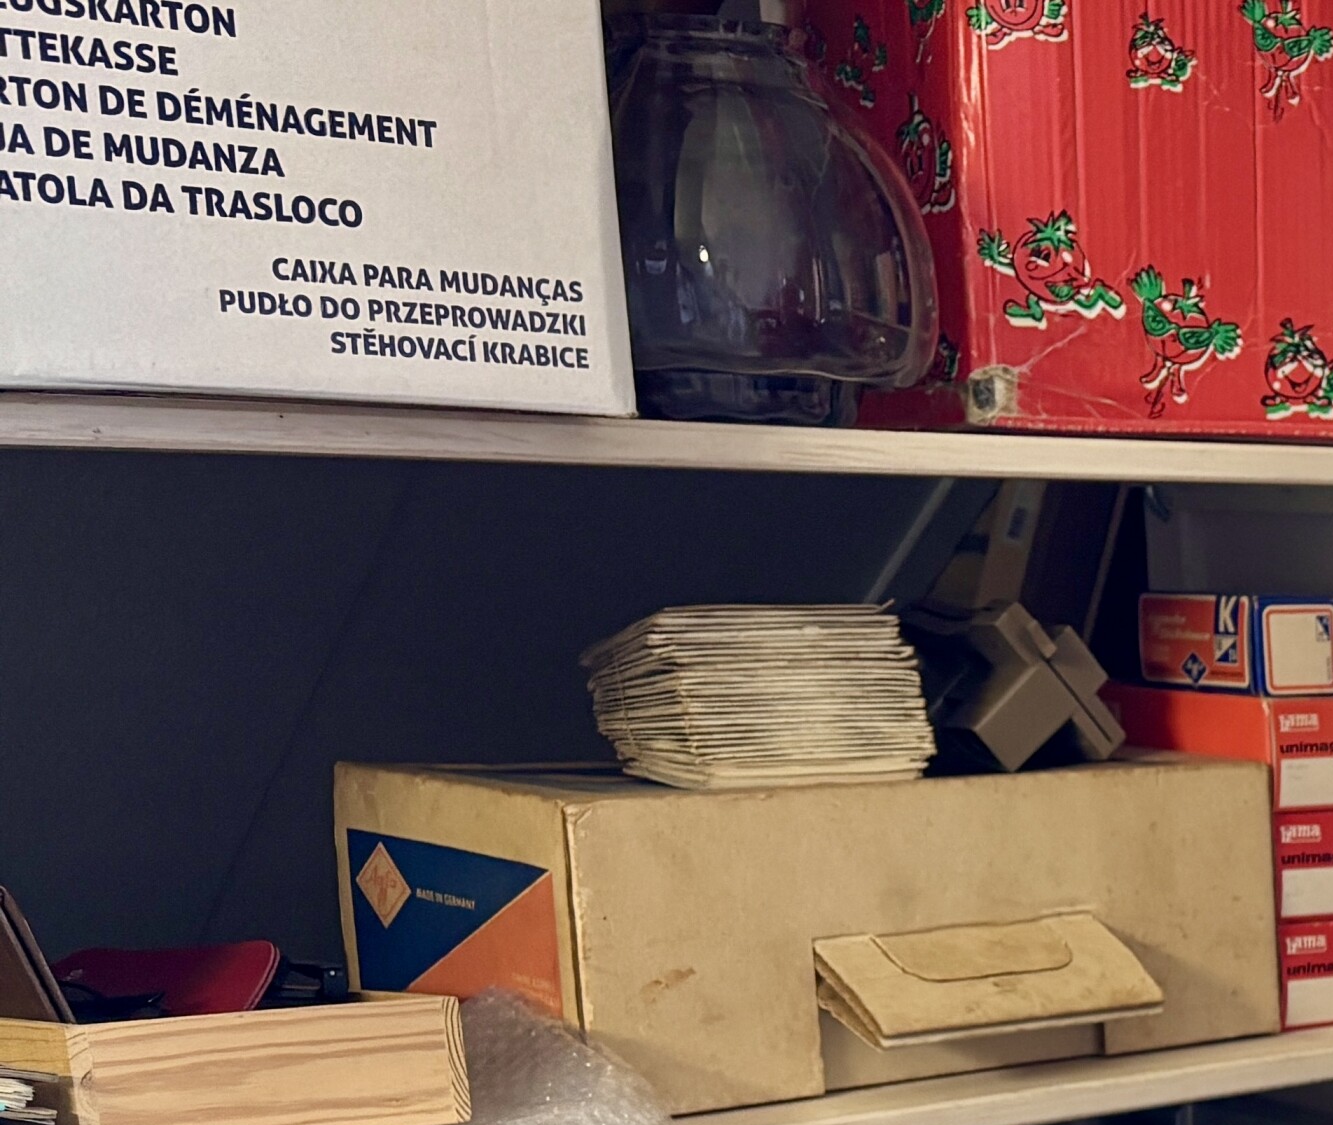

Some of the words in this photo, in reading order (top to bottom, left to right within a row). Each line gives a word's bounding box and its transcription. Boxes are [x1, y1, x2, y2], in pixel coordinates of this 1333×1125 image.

[0, 0, 237, 37] GSKARTON
[99, 85, 148, 119] DE
[156, 88, 437, 148] DÉMÉNAGEMENT
[43, 126, 94, 160] DE
[103, 132, 285, 177] MUDANZA
[122, 181, 175, 213] DA
[181, 185, 363, 228] TRASLOCO
[271, 257, 356, 286] CAIXA
[363, 264, 434, 292] PARA
[439, 270, 584, 306] MUDANÇAS
[219, 289, 312, 318] PUDŁO
[320, 297, 361, 321] DO
[368, 299, 587, 336] PRZEPROWADZKI
[330, 328, 477, 362] STĚHOVACÍ
[482, 342, 590, 370] KRABICE
[1219, 595, 1239, 634] K
